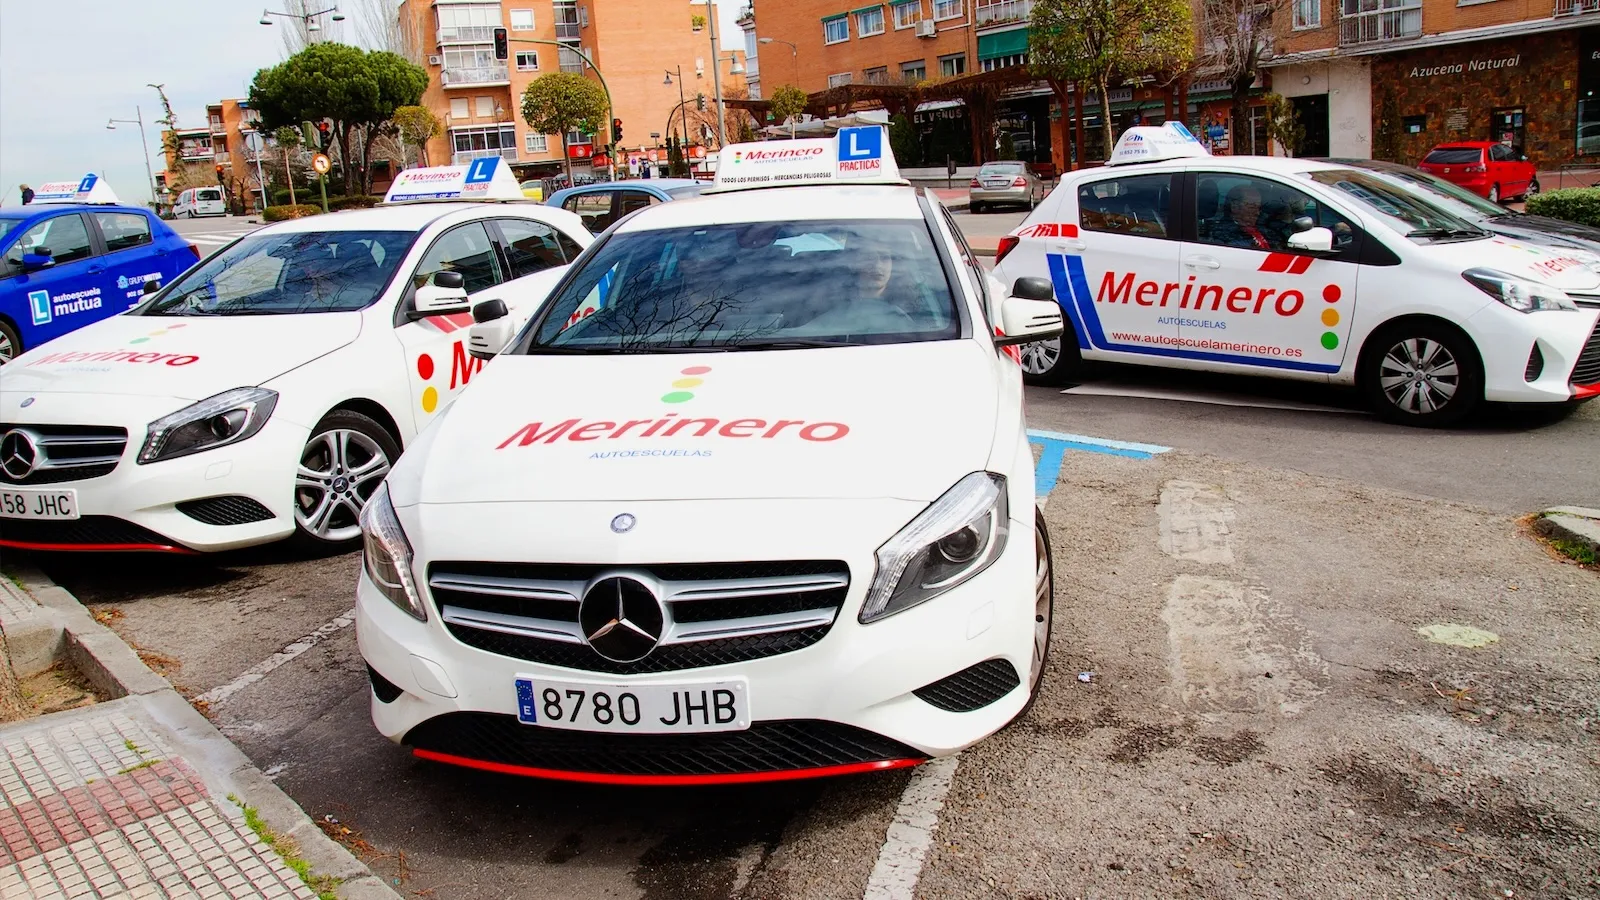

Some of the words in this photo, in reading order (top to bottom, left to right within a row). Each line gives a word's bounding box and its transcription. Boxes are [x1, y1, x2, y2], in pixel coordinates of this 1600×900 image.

[1410, 63, 1463, 78] Azucena
[1468, 54, 1520, 72] Natural
[913, 114, 925, 124] EL
[850, 133, 870, 156] L
[745, 147, 824, 161] Merinero
[754, 156, 814, 164] AUTOESCUELAS
[473, 161, 487, 180] L
[839, 159, 880, 172] PRACTICAS
[81, 178, 90, 191] L
[409, 171, 461, 181] Merinero
[774, 173, 803, 182] MERCANCIAS
[803, 172, 832, 180] PELIGROSAS
[463, 183, 490, 191] PRACTICAS
[53, 287, 101, 303] autoescuela
[1096, 271, 1305, 317] Merinero
[33, 297, 48, 319] L
[54, 297, 103, 317] mutua
[1157, 316, 1226, 330] AUTOESCUELAS
[1112, 331, 1303, 358] www.autoescuelamerinero.es
[25, 348, 200, 367] Merinero
[495, 413, 850, 450] Merinero
[588, 449, 712, 460] AUTOESCUELAS
[0, 493, 26, 514] 58
[34, 495, 71, 516] JHC
[522, 705, 532, 716] E
[542, 687, 641, 726] 8780
[659, 689, 736, 726] JHB
